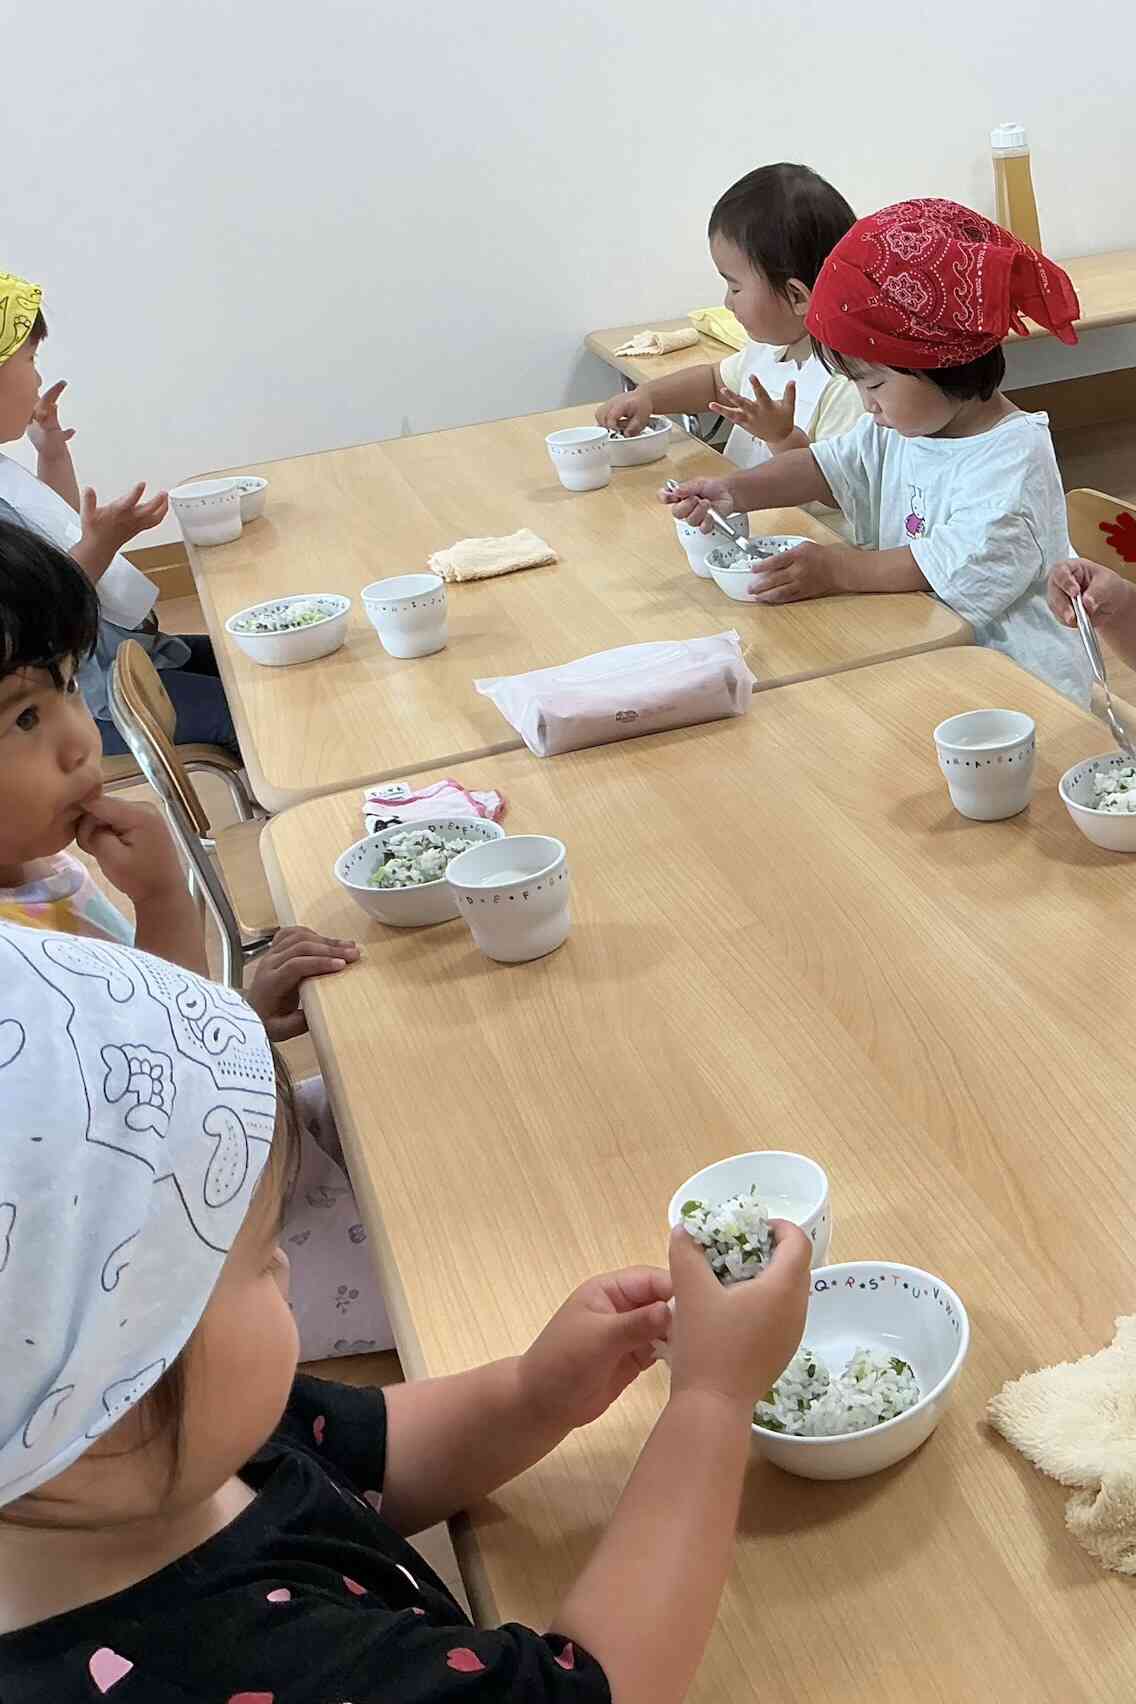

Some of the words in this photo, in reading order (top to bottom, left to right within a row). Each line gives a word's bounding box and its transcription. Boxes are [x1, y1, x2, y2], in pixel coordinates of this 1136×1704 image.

[814, 1279, 830, 1292] Q
[845, 1276, 855, 1288] R
[868, 1278, 879, 1290] S
[892, 1275, 900, 1286] T
[912, 1287, 920, 1298] U
[932, 1287, 940, 1299] V
